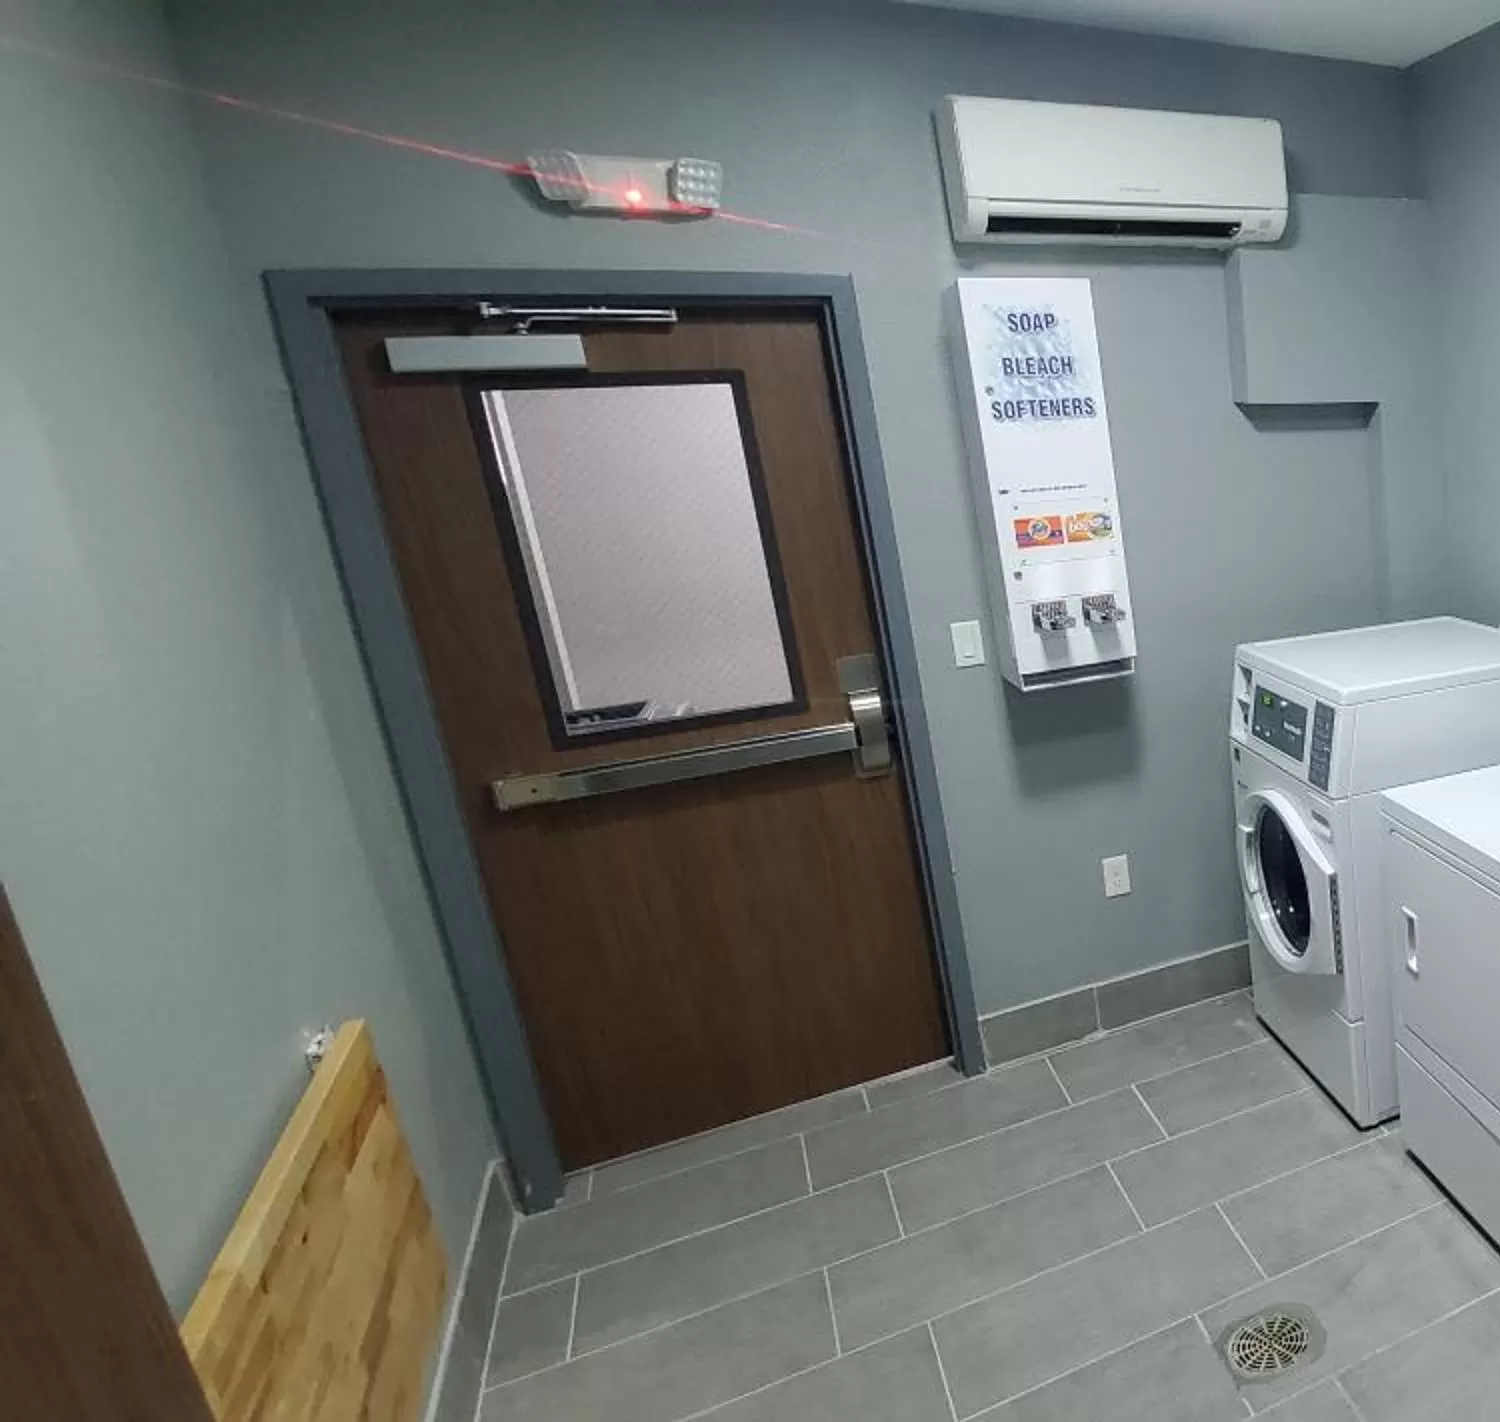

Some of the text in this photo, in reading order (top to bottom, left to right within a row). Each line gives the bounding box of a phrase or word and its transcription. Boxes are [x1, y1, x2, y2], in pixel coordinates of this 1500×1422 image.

[1007, 313, 1056, 332] SOAP
[1002, 356, 1073, 376] BLEACH
[992, 397, 1095, 420] SOFTENERS
